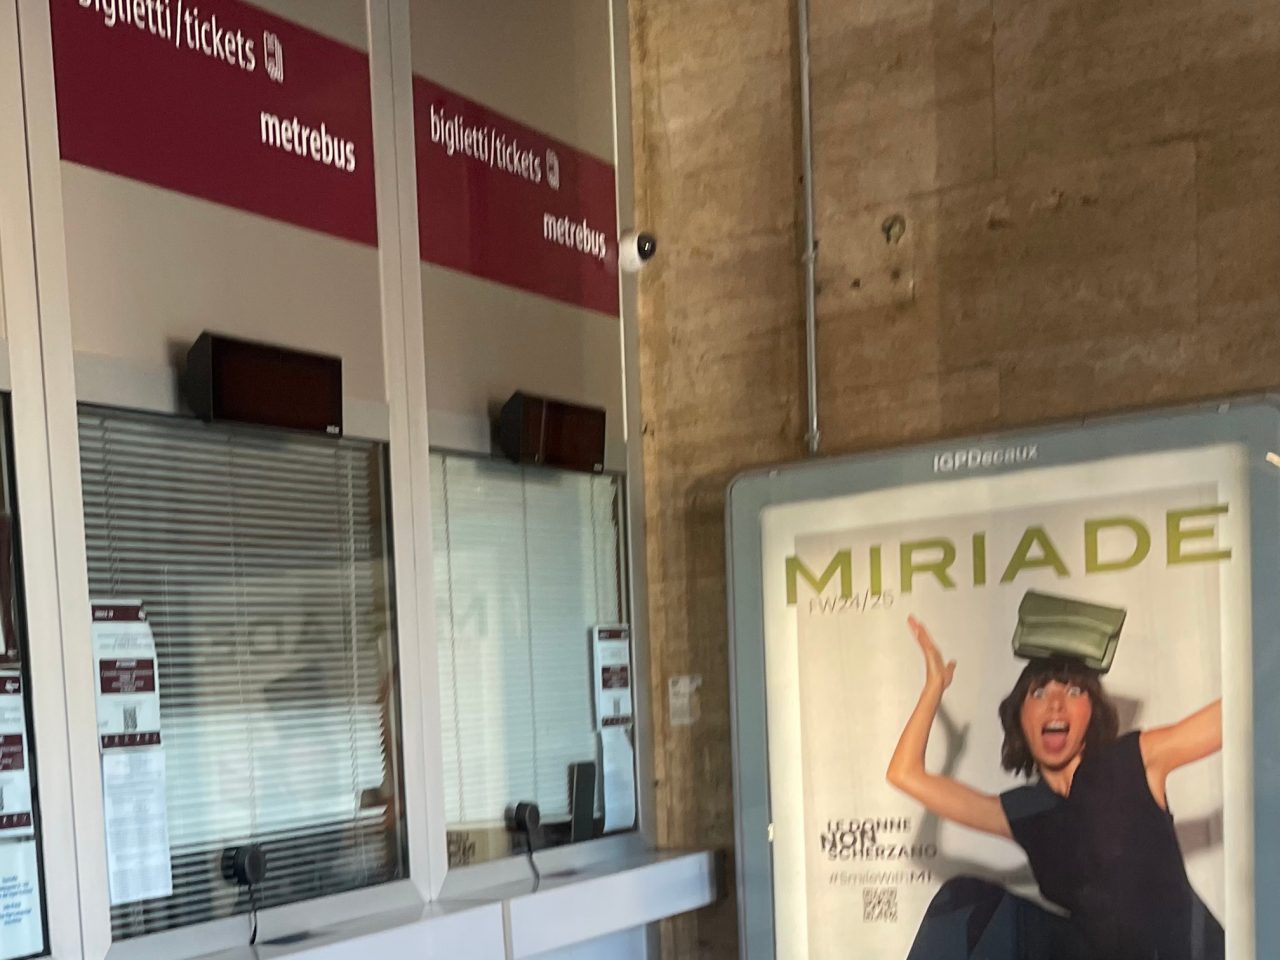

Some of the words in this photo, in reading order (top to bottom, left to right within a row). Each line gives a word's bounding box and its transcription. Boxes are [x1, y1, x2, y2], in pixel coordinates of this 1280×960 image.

[79, 0, 255, 71] gietti/tickets
[260, 110, 356, 173] metrebus
[430, 103, 542, 184] biglietti/tickets
[543, 212, 607, 259] metrebus
[933, 444, 1038, 473] IGPDecaux
[785, 503, 1232, 605] MIRIADE
[820, 828, 877, 852] NON
[828, 844, 938, 861] SCHERZANO
